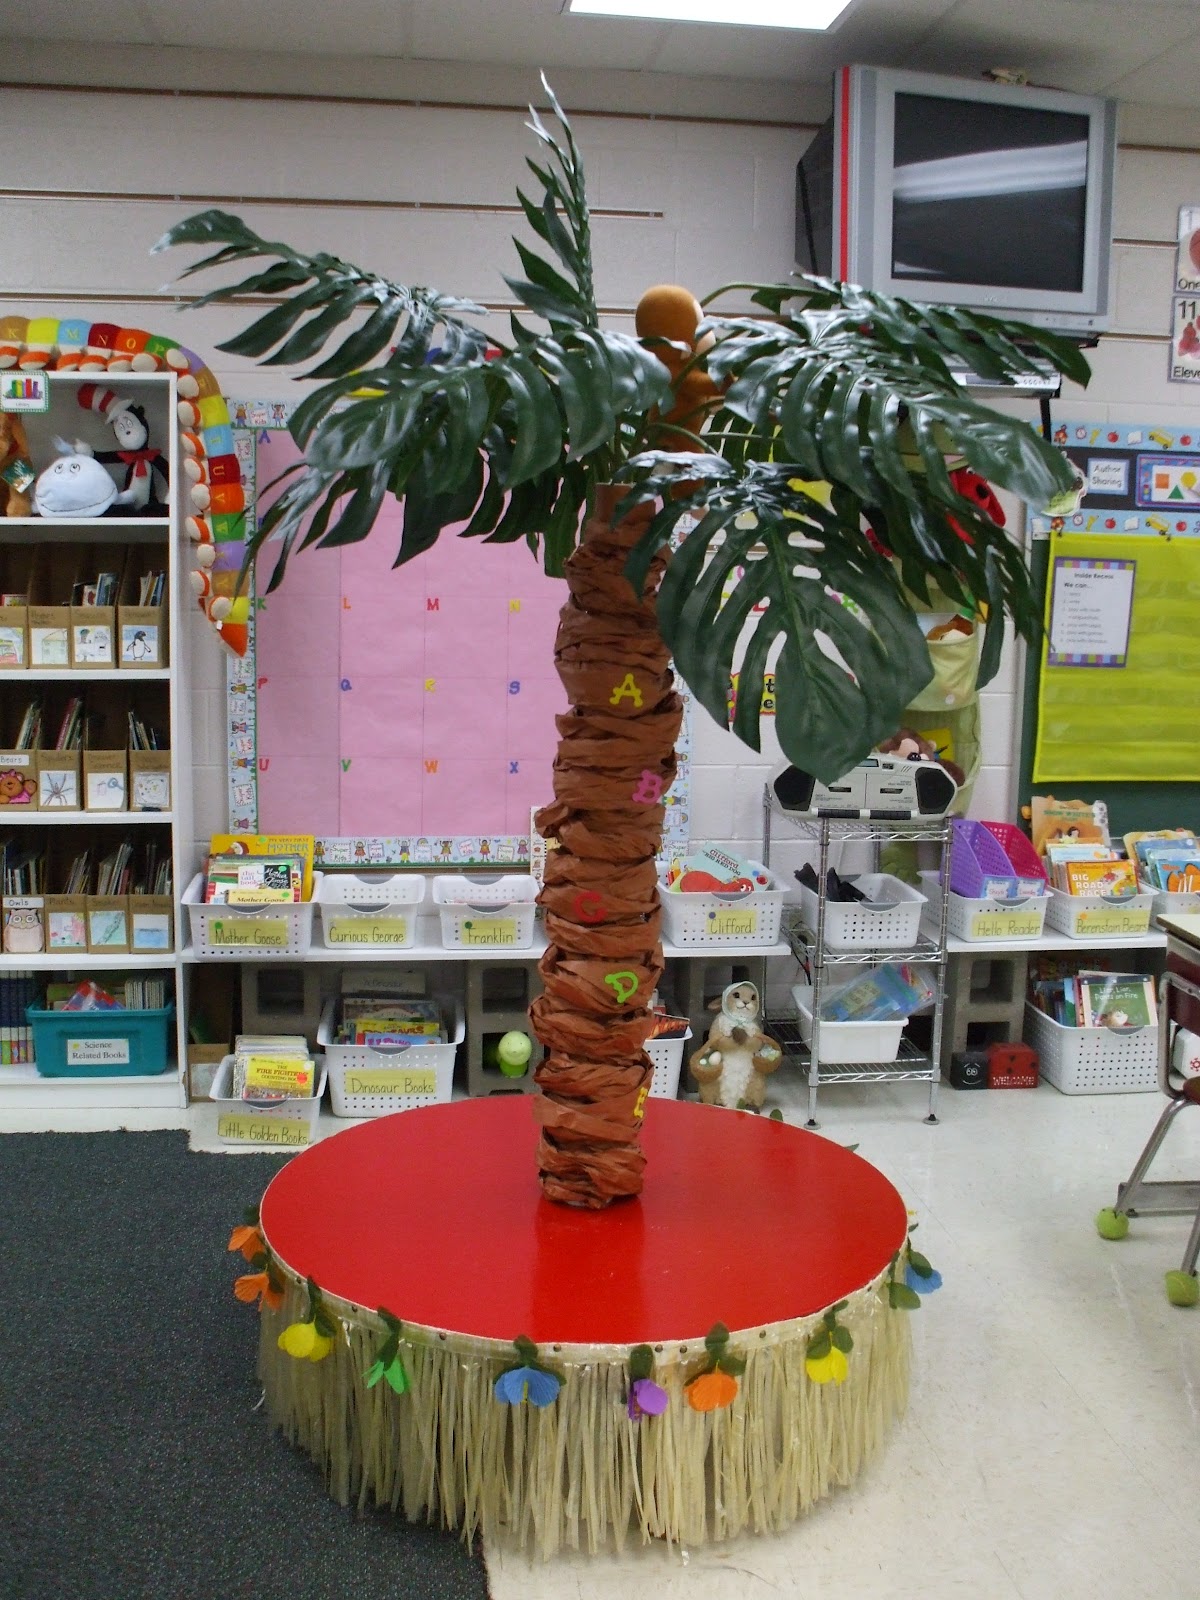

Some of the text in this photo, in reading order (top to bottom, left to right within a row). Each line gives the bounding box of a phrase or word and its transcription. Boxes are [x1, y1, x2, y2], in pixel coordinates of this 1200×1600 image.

[1178, 301, 1196, 319] 11
[8, 328, 19, 338] K
[67, 329, 79, 340] M
[97, 334, 108, 346] N
[125, 337, 136, 349] O
[259, 428, 271, 445] A
[213, 464, 225, 477] U
[1093, 464, 1121, 473] Author
[1091, 476, 1122, 489] Sharing
[214, 493, 226, 505] V
[257, 598, 267, 610] K
[343, 597, 351, 609] L
[427, 597, 440, 611] M
[509, 599, 521, 613] N
[257, 677, 268, 689] P
[340, 678, 352, 692] Q
[424, 678, 436, 692] R
[509, 680, 520, 695] S
[609, 673, 644, 708] A
[1, 756, 23, 764] Bears
[259, 758, 270, 772] U
[341, 759, 351, 772] V
[425, 760, 439, 773] W
[510, 761, 519, 774] X
[632, 768, 663, 805] B
[267, 843, 309, 853] MOTHER
[332, 844, 349, 854] Super
[334, 854, 347, 862] Kids
[709, 848, 740, 869] Clifford
[265, 867, 288, 879] Mother
[715, 859, 730, 870] RED
[728, 866, 741, 877] DOG
[265, 877, 289, 887] Goose
[1072, 873, 1089, 881] BIG
[1076, 881, 1104, 889] ROAD
[574, 890, 607, 923] C
[710, 918, 752, 934] Clifford
[977, 919, 1040, 937] Hello Reader
[1122, 917, 1147, 933] Bears
[215, 928, 282, 945] Mother Goose
[329, 926, 368, 943] Curious
[468, 927, 513, 944] Franklin
[604, 970, 639, 1004] D
[84, 1041, 112, 1049] Science
[72, 1051, 126, 1060] Related Books
[351, 1077, 434, 1094] Dinosaur Books
[633, 1086, 649, 1118] E
[217, 1122, 309, 1145] Little Golden Books
